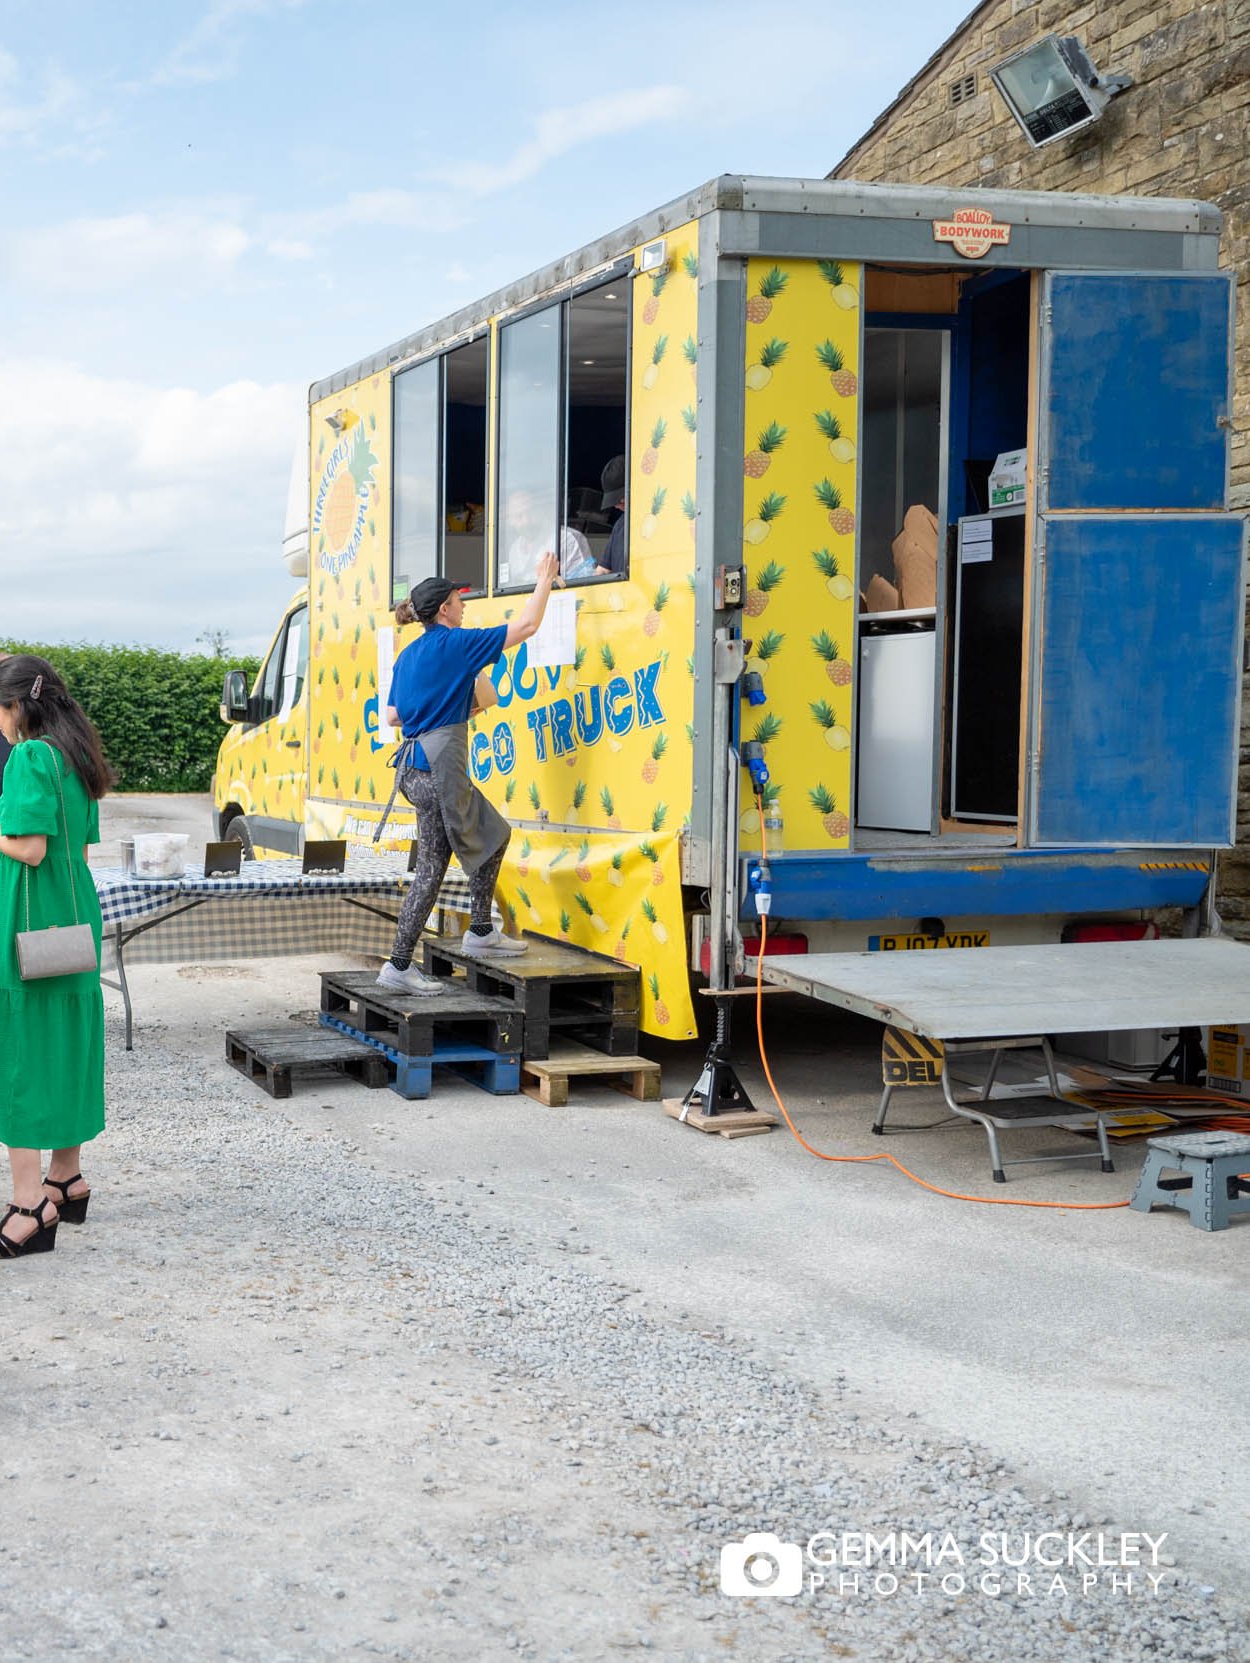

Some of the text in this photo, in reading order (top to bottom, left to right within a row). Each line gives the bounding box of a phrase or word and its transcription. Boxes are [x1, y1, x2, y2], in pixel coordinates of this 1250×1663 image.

[940, 226, 1005, 239] BODYWORK
[326, 437, 350, 479] GIRLS
[320, 551, 338, 575] ONE
[467, 721, 517, 784] CO
[526, 660, 667, 763] TRUCK
[885, 1060, 943, 1082] DEL
